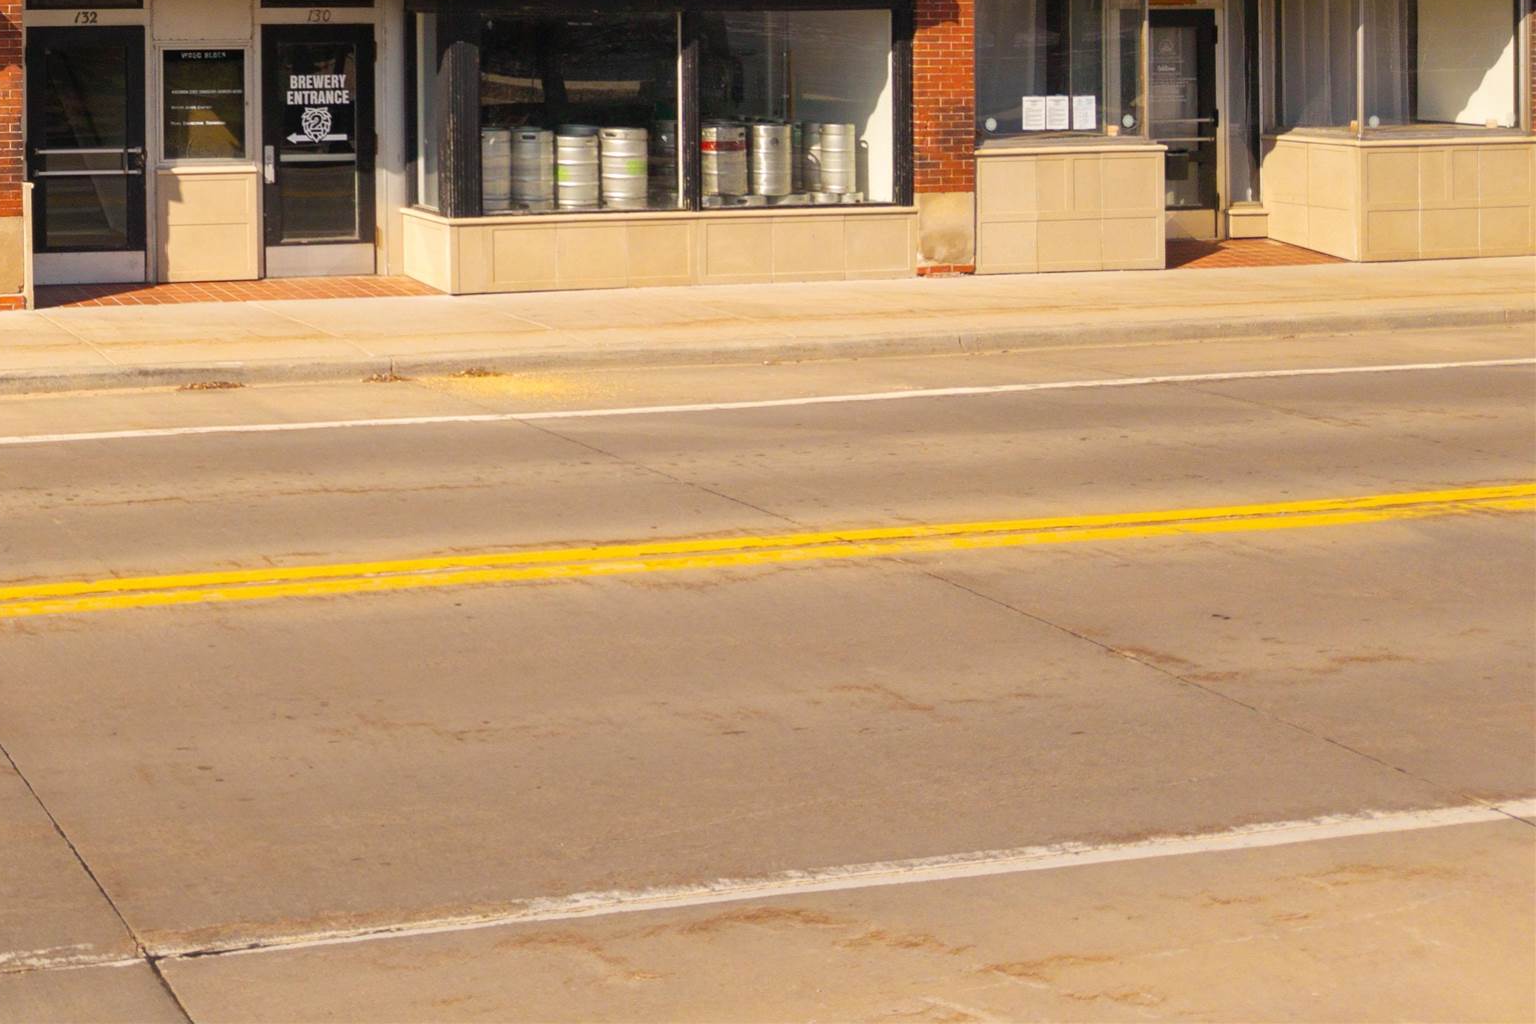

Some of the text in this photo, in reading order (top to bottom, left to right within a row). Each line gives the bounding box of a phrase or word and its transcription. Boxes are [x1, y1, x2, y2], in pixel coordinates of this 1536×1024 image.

[74, 11, 99, 24] 132
[307, 9, 332, 22] 130
[289, 74, 347, 89] BREWERY
[286, 89, 350, 105] ENTRANCE
[311, 115, 322, 133] 2
